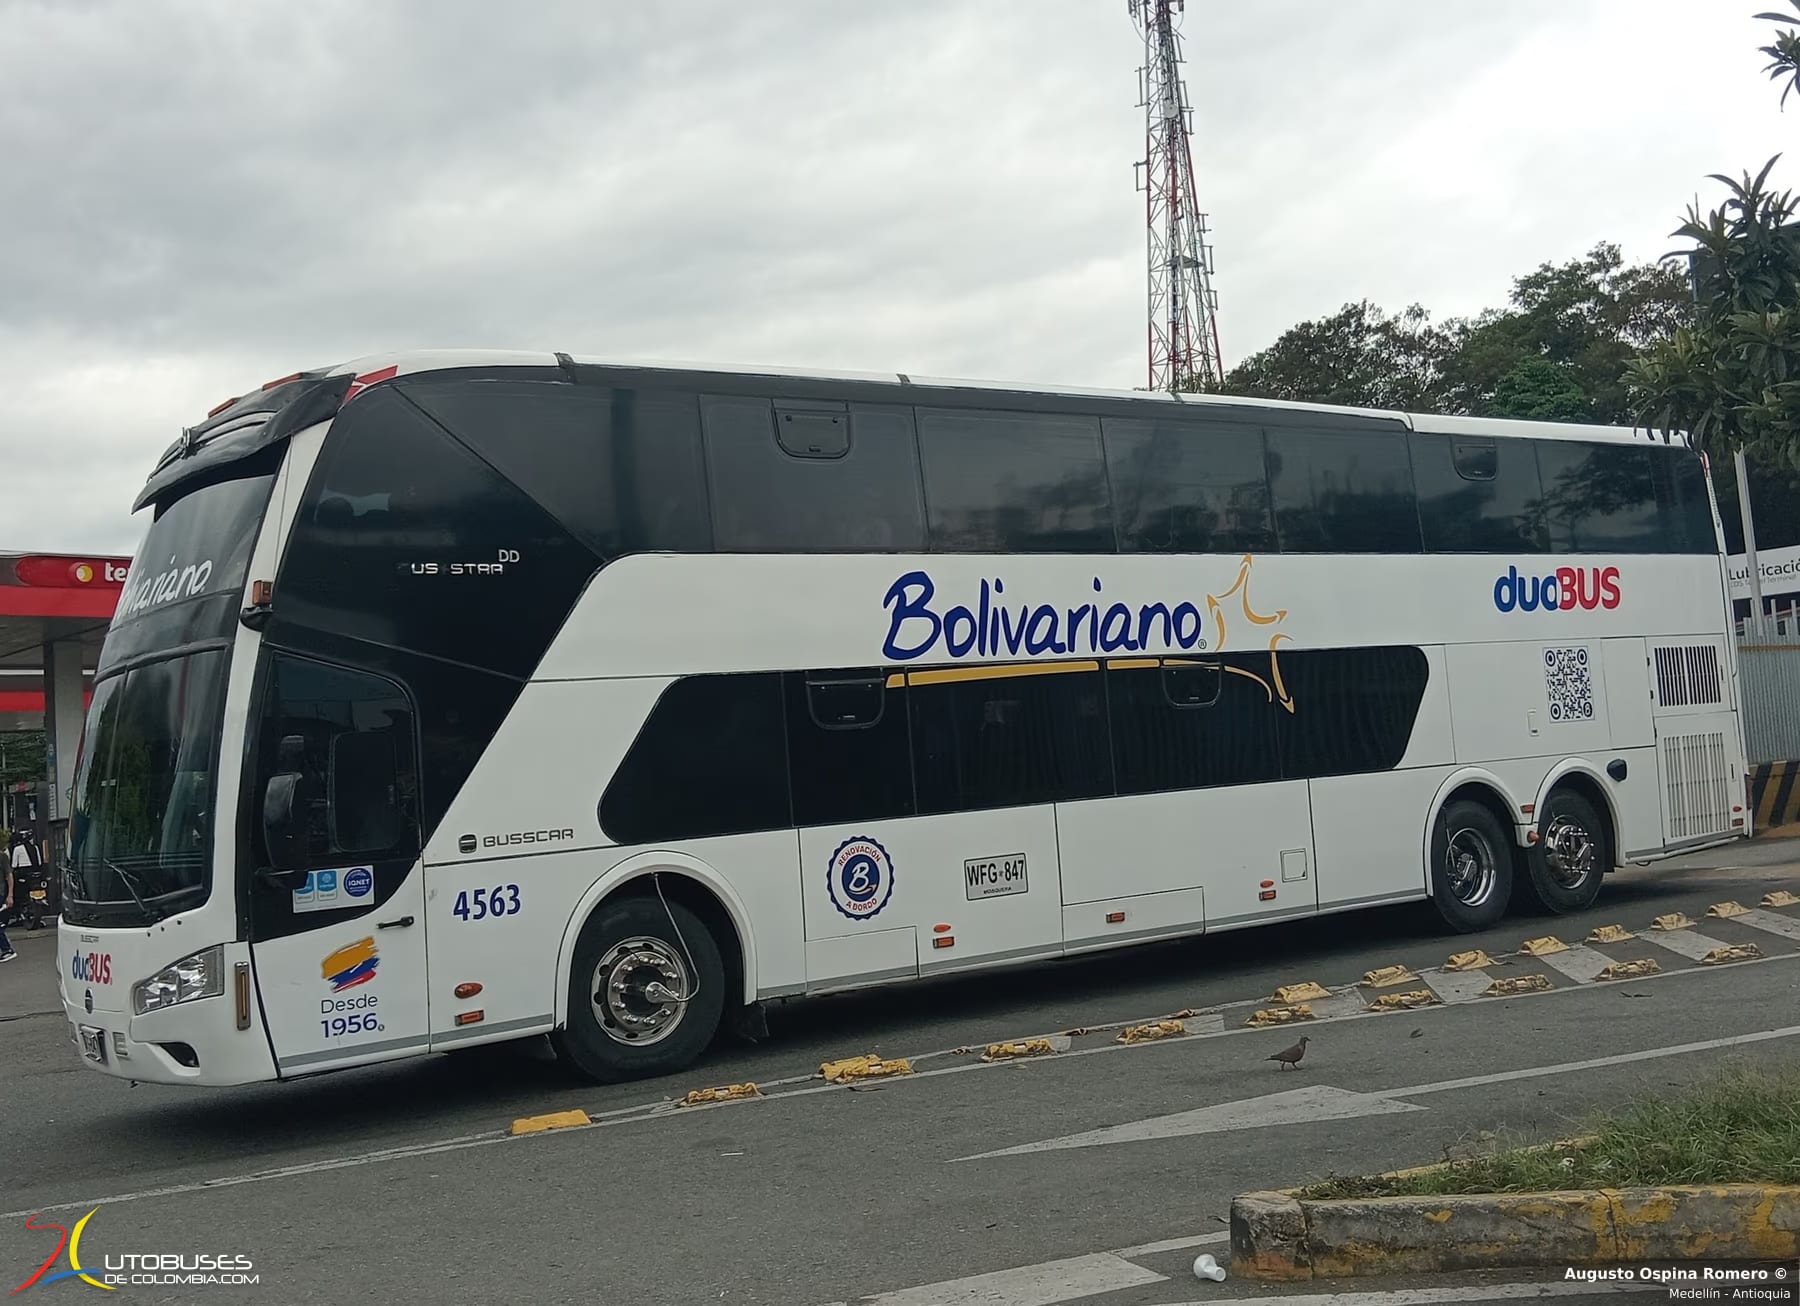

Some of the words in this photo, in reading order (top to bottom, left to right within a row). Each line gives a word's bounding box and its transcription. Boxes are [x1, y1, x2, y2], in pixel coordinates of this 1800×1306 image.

[498, 549, 520, 562] DD
[105, 562, 130, 581] te
[450, 563, 503, 575] STAR
[1494, 565, 1621, 612] duoBUS
[882, 571, 1201, 660] Bolivariano
[483, 828, 574, 848] BUSSCAR
[838, 845, 881, 866] RENOVACIÓN
[453, 884, 521, 921] 4563
[321, 993, 379, 1015] Desde
[321, 1012, 378, 1039] 1956
